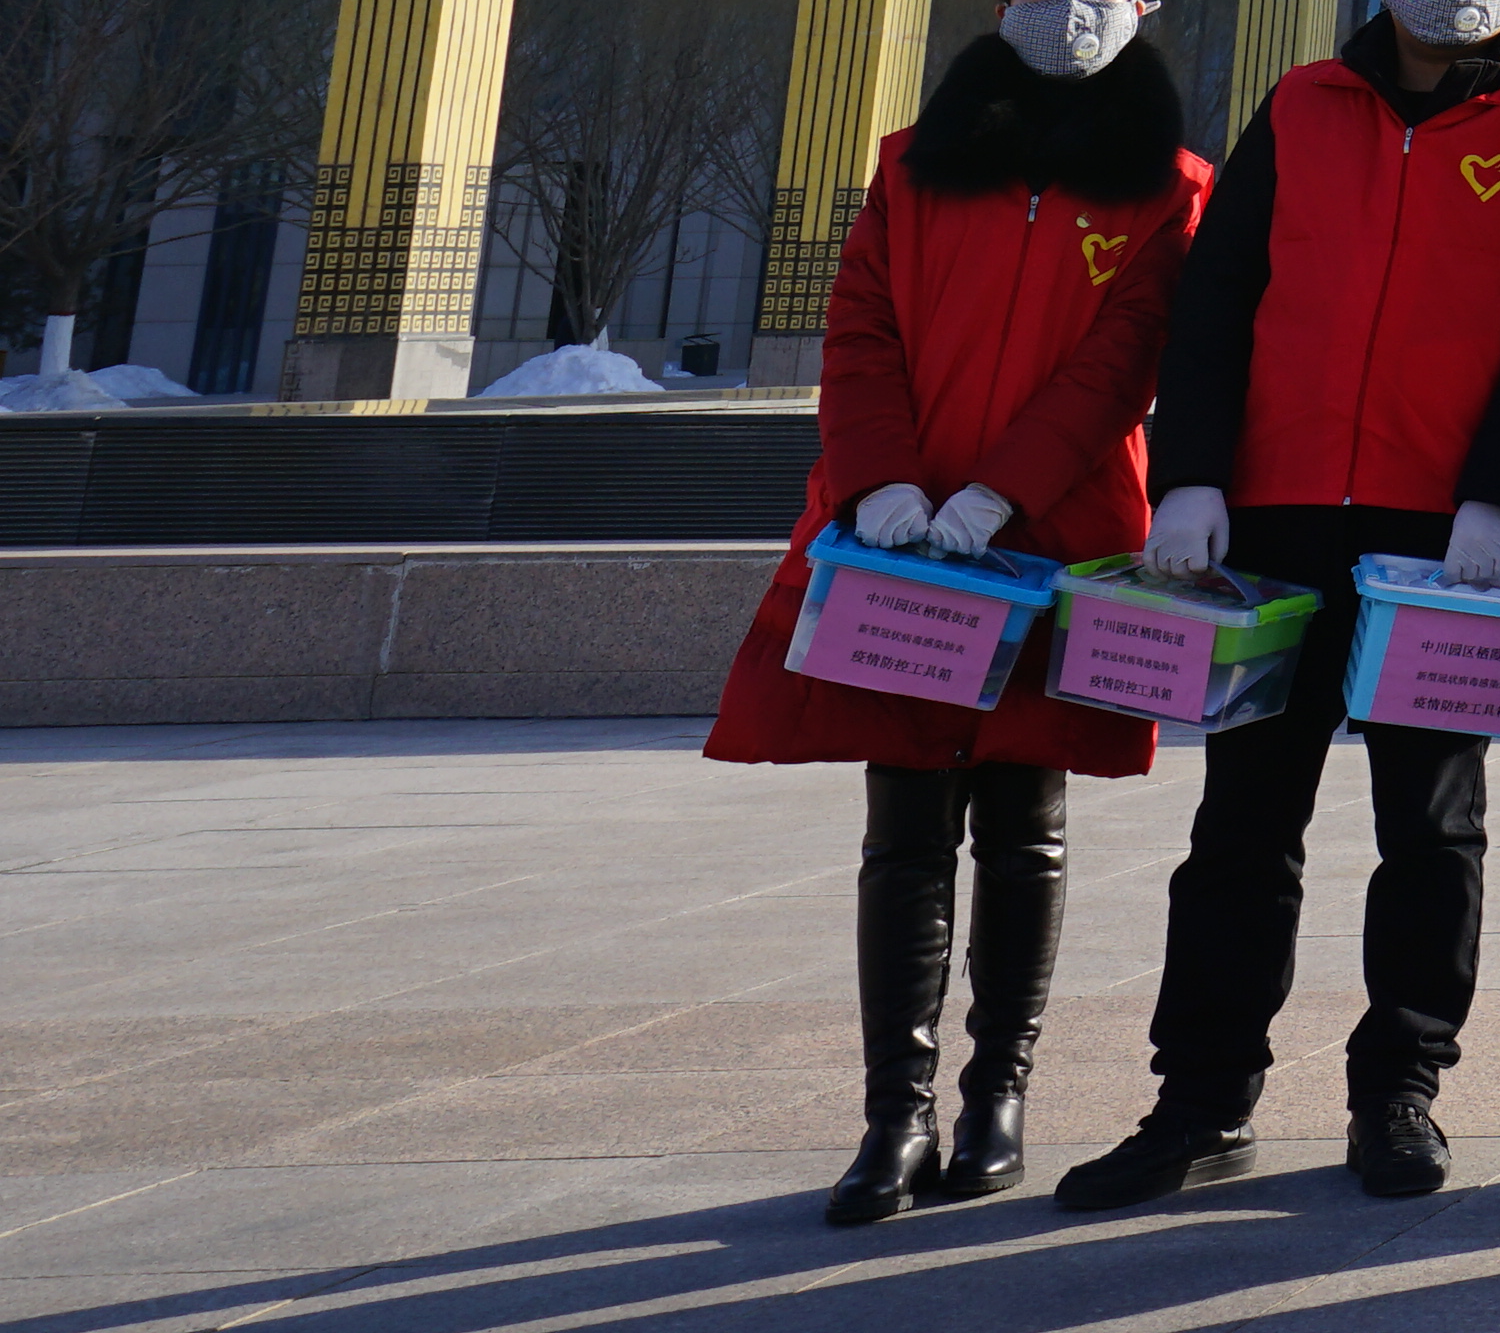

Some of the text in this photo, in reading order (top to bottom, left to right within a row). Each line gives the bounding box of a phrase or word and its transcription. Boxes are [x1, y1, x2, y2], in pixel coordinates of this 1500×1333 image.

[865, 591, 981, 629] 中川园区栖霞街道
[857, 623, 966, 656] 新型冠状病毒感染肺炎
[1092, 616, 1186, 648] 中川园区栖霞街道
[850, 649, 954, 683] 疫情防控工具箱
[1090, 647, 1180, 675] 新型冠状病毒感染肺炎
[1089, 674, 1173, 702] 疫情防控工具箱
